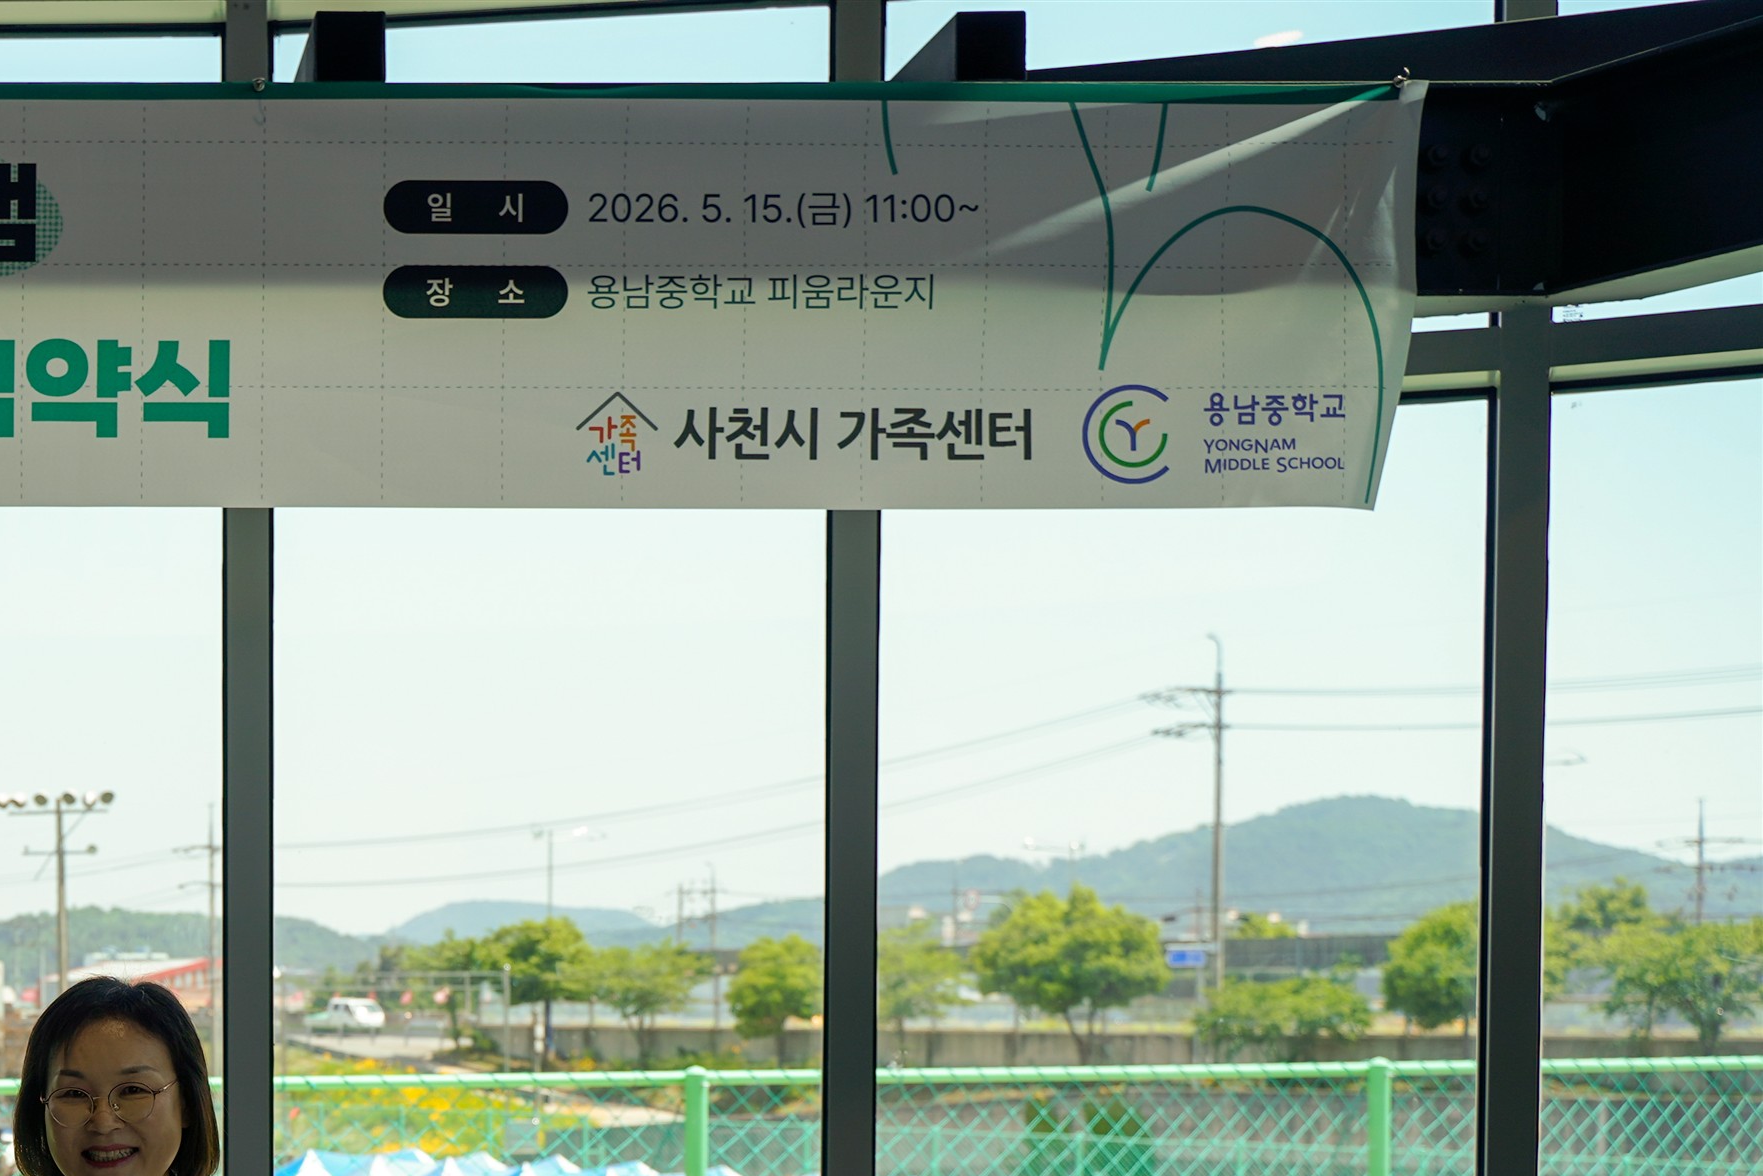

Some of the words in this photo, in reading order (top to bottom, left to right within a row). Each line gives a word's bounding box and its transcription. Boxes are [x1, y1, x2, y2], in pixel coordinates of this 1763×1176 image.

[588, 193, 689, 223] 2026.
[701, 193, 732, 223] 5.
[743, 192, 852, 229] 15.(금)
[866, 193, 980, 223] 11:00~
[587, 273, 757, 310] 용남중학교
[767, 273, 935, 310] 피움라운지
[1203, 392, 1346, 427] 용남중학교
[588, 415, 638, 452] 가족
[673, 407, 819, 460] 사천시
[838, 407, 1034, 460] 가족센터
[1203, 438, 1297, 454] YONGNAM
[586, 442, 641, 476] 센터
[1204, 457, 1271, 474] MIDDLE
[1276, 456, 1346, 473] SCHOOL
